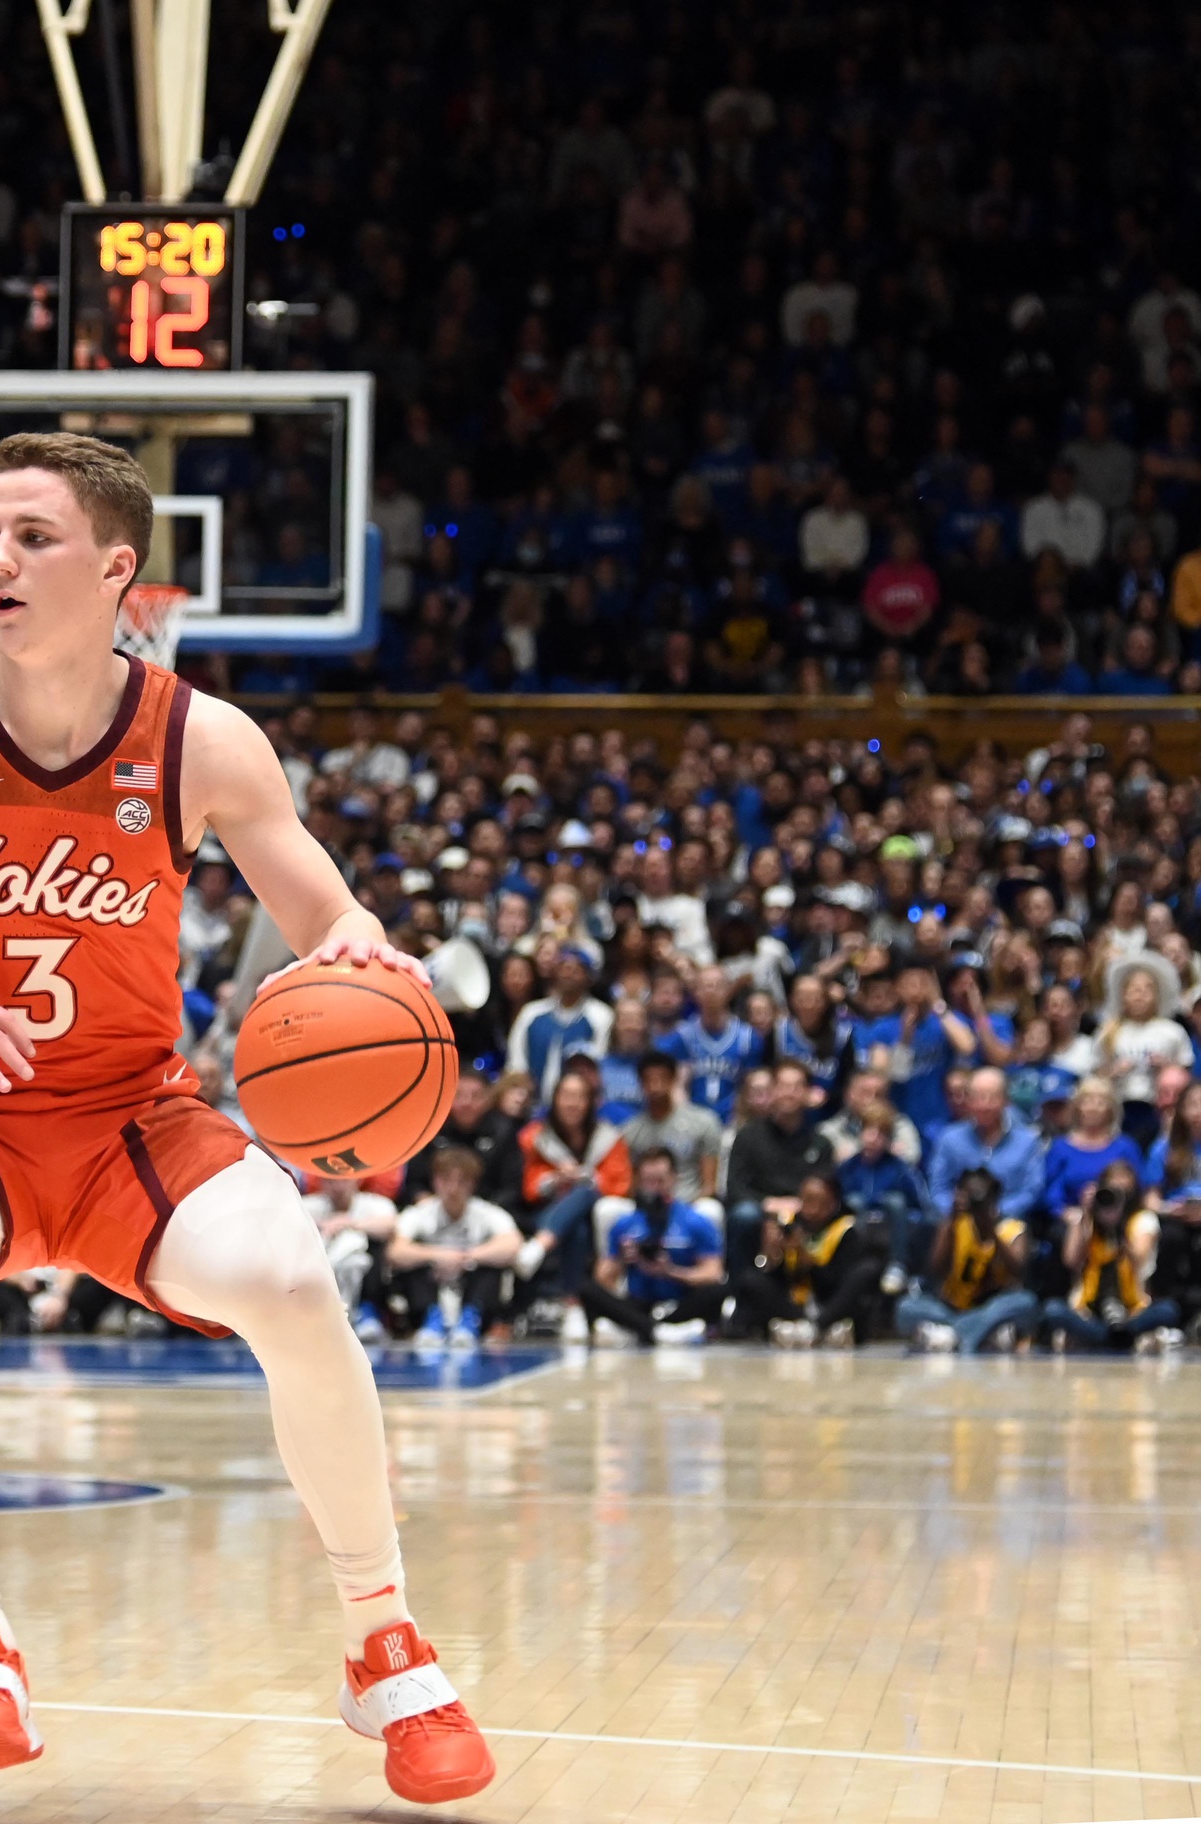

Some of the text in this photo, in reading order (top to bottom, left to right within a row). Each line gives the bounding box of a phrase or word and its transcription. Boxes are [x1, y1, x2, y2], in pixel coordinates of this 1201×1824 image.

[100, 222, 226, 276] 15:20
[129, 276, 210, 367] 12
[122, 810, 147, 820] ACC
[3, 935, 82, 1042] 3
